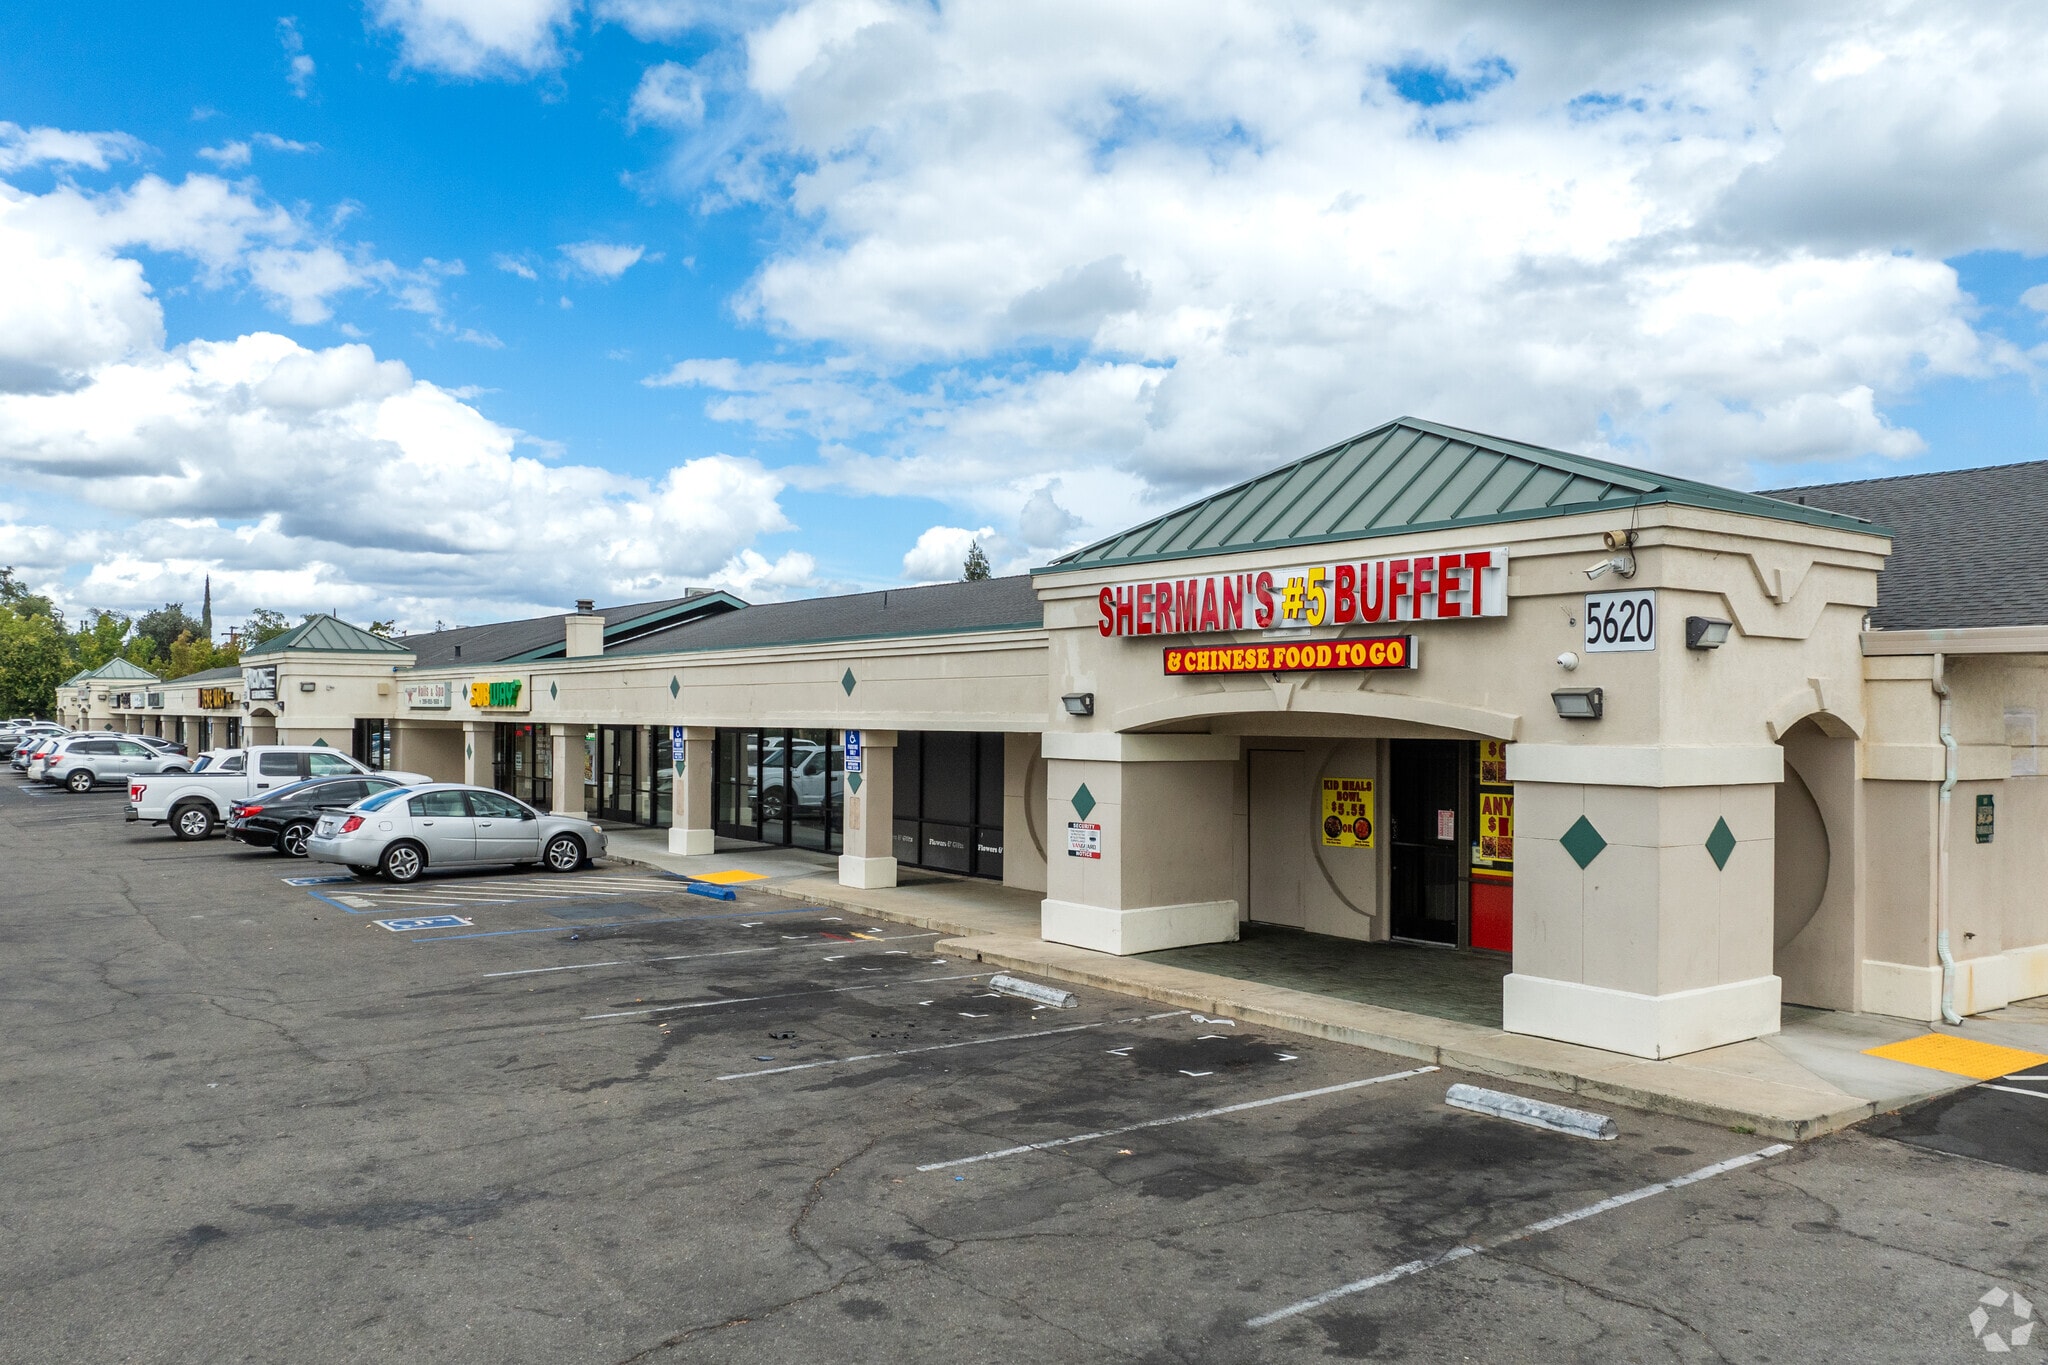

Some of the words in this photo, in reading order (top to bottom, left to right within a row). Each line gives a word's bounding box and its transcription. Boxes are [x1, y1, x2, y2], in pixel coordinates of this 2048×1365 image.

[1098, 571, 1275, 637] SHERMAN'S
[1282, 567, 1327, 626] #5
[1334, 551, 1491, 623] BUFFET
[1587, 598, 1653, 645] 5620
[1167, 652, 1181, 672] &
[1184, 648, 1270, 672] CHINESE
[1273, 645, 1332, 669] FOOD
[1335, 643, 1367, 666] TO
[1369, 641, 1404, 664] GO
[470, 680, 521, 708] SUBWAY
[1324, 780, 1339, 790] KID
[1342, 781, 1372, 791] MEALS
[1336, 791, 1362, 802] BOWL
[1482, 796, 1513, 816] ANY
[1342, 824, 1352, 833] OR
[929, 838, 947, 848] Flowers
[977, 844, 998, 854] Flowers
[1075, 850, 1093, 858] NOTICE
